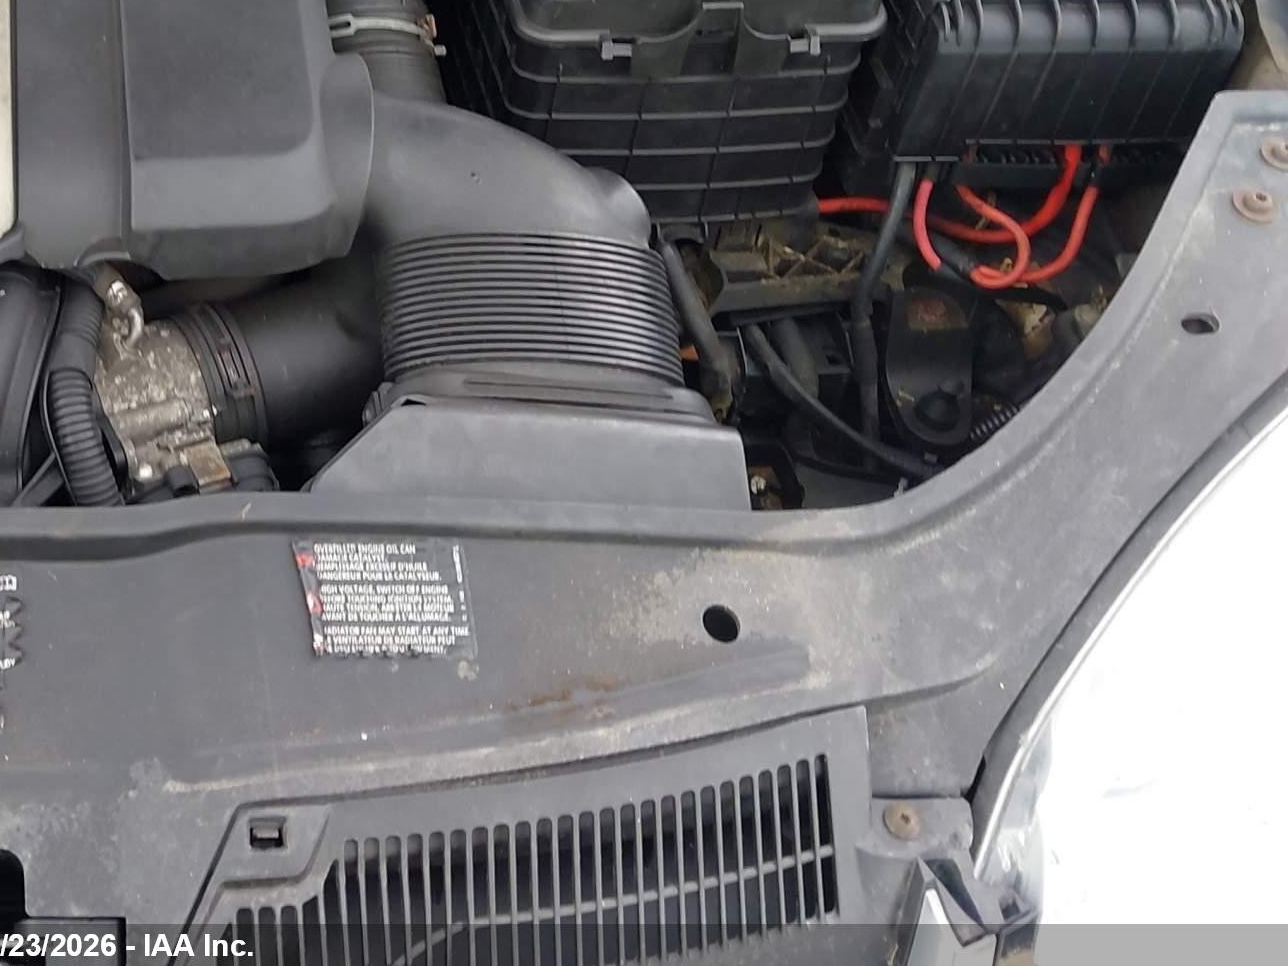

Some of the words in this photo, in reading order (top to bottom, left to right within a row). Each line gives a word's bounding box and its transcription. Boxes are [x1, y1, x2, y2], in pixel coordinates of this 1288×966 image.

[314, 544, 356, 554] OVERFILLED
[358, 544, 385, 554] ENGINE
[386, 544, 399, 554] OIL
[400, 544, 416, 554] CAN
[377, 585, 406, 594] SWITCH
[421, 585, 448, 594] ENGINE
[361, 626, 376, 635] FAN
[378, 626, 395, 635] MAY
[398, 626, 419, 635] START
[422, 626, 431, 635] AT
[433, 626, 449, 635] ANY
